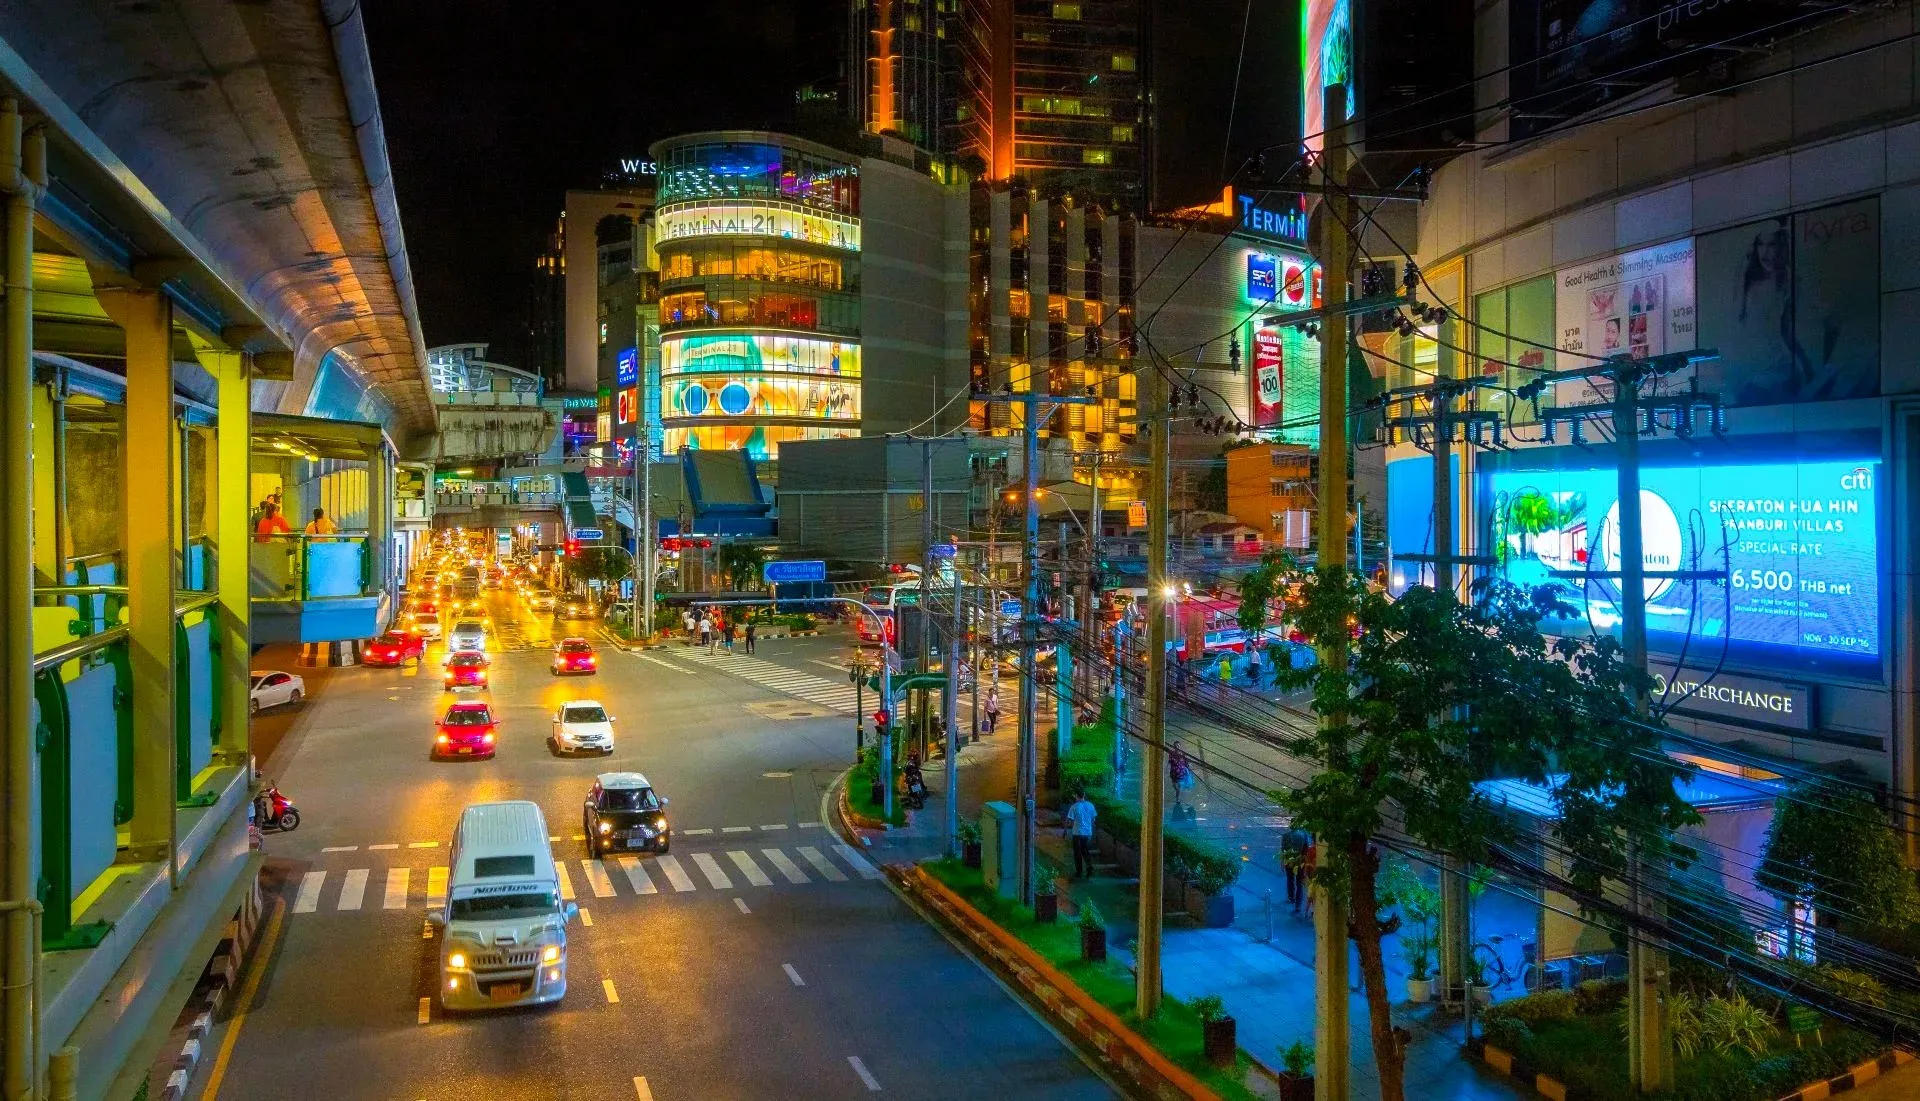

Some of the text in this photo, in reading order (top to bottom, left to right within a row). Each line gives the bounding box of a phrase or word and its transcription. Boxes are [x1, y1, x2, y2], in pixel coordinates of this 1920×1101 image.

[753, 214, 775, 234] 21
[1564, 247, 1694, 288] Good Health & Slimming Massage
[1261, 375, 1279, 394] 100
[1840, 472, 1872, 491] citi
[1708, 499, 1859, 514] SHERATON HUA HIN
[1792, 519, 1844, 533] VILLAS
[1738, 541, 1823, 556] SPECIAL RATE
[1731, 568, 1793, 592] 6,500
[1800, 579, 1827, 593] THB
[1829, 581, 1852, 596] net
[1803, 633, 1822, 643] NOW
[1840, 636, 1857, 647] SEP
[1671, 680, 1793, 713] INTERCHANGE
